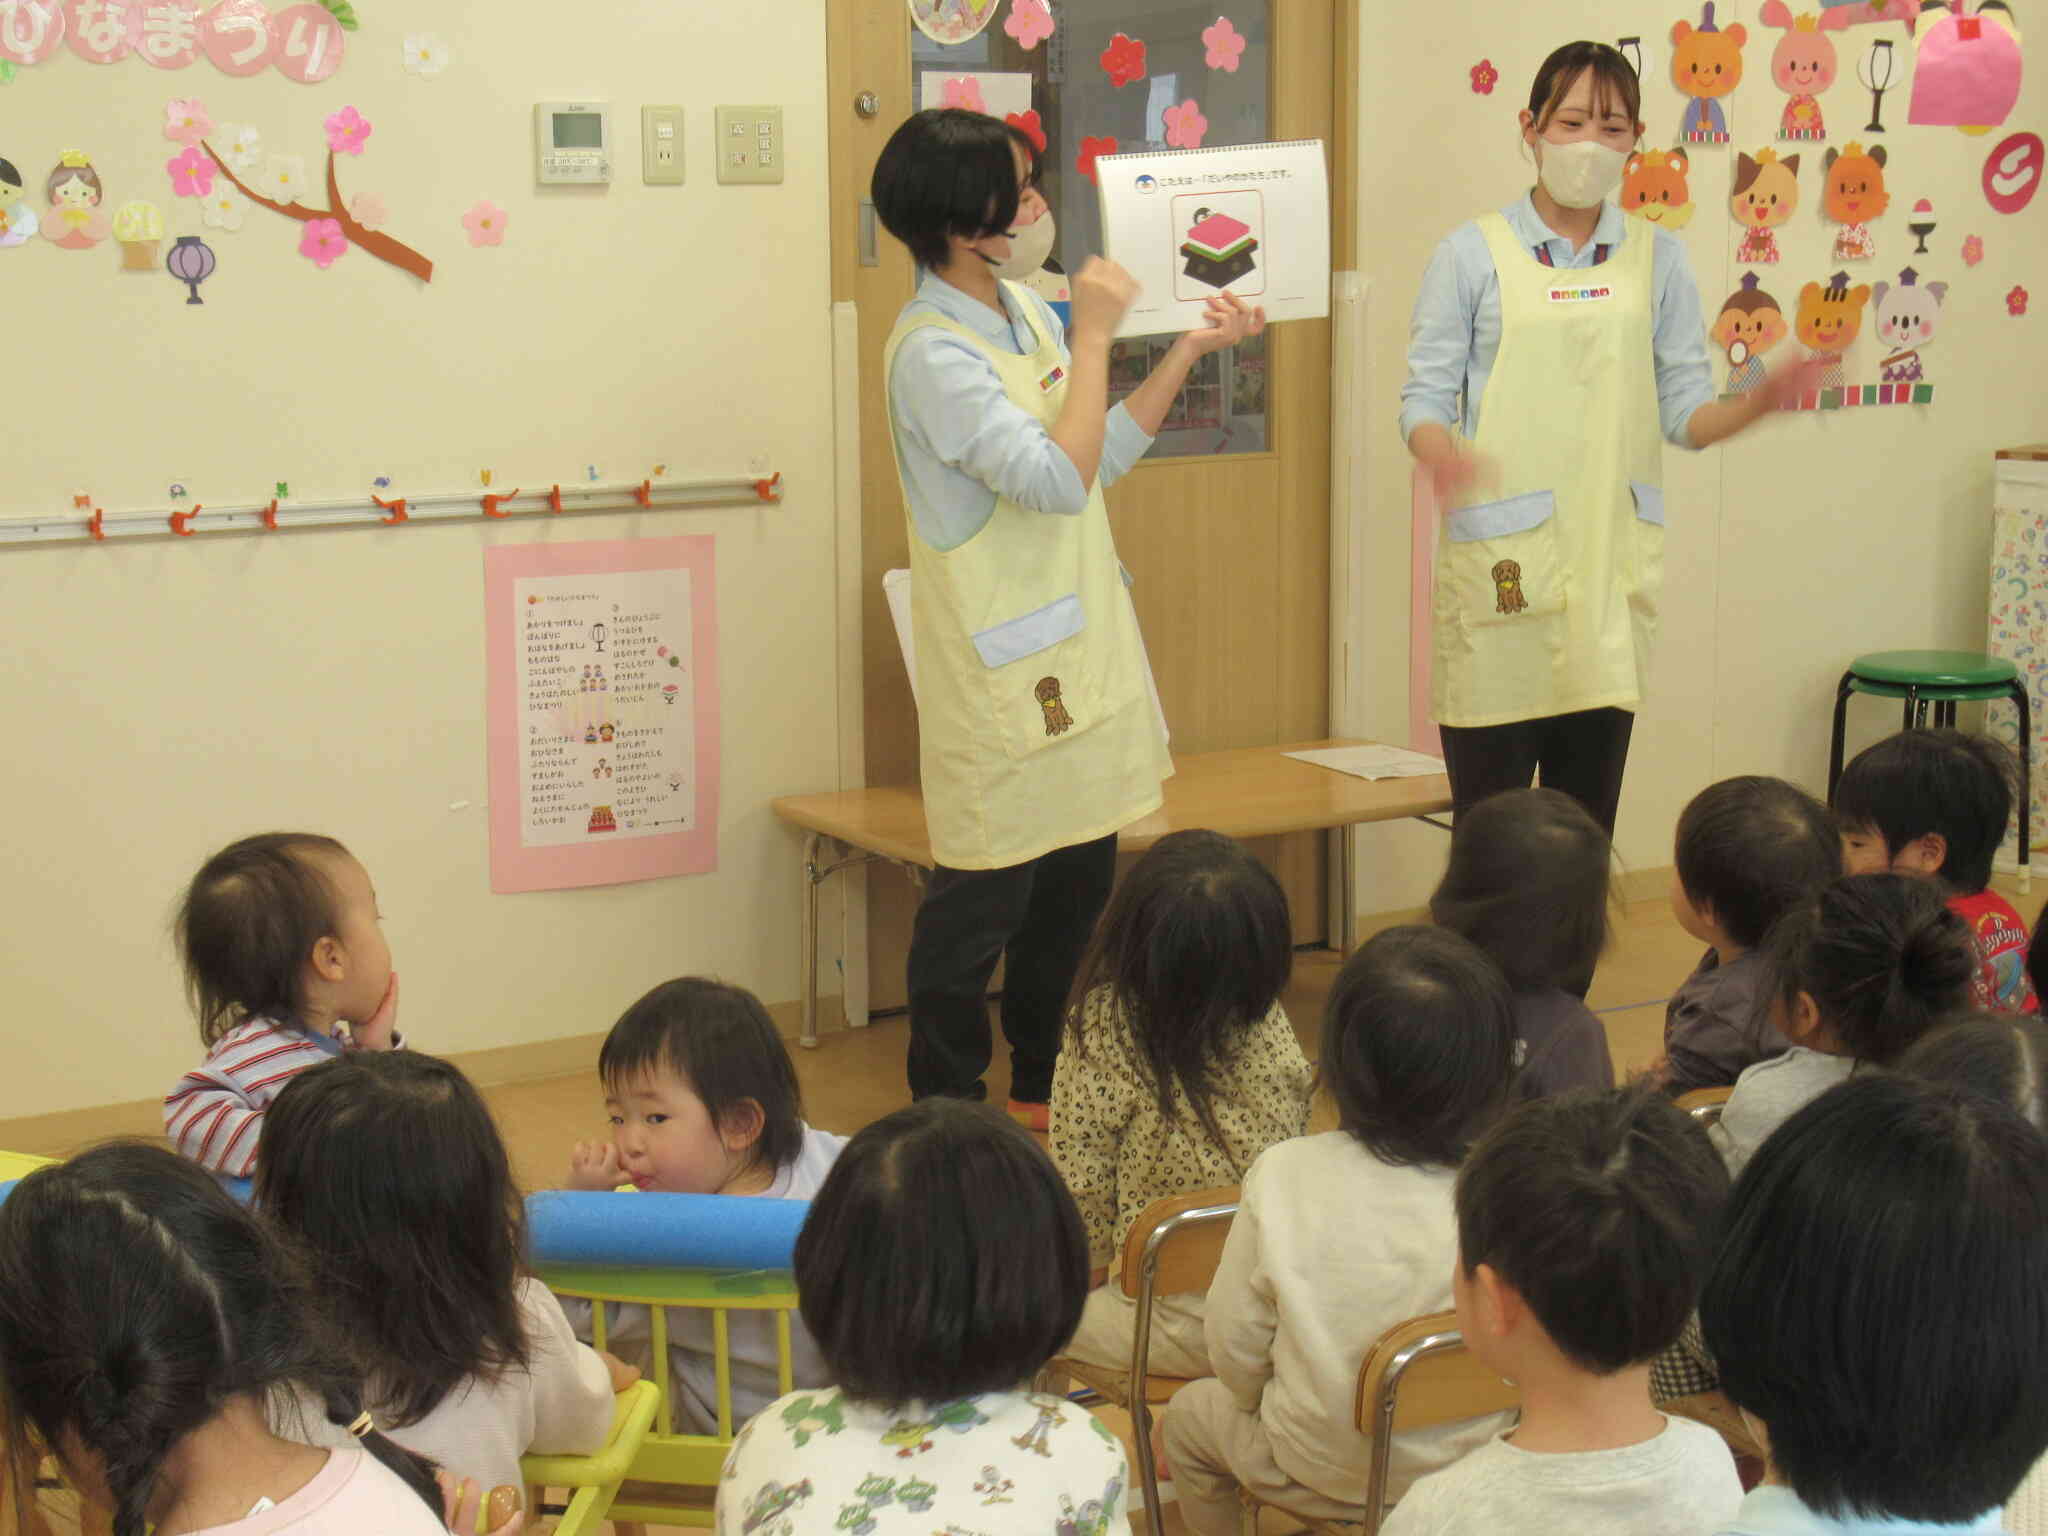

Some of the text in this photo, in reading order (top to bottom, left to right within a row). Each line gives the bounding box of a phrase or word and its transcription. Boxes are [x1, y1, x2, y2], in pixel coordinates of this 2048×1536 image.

[0, 0, 329, 80] ひなまつり
[529, 702, 562, 712] ひなまつり
